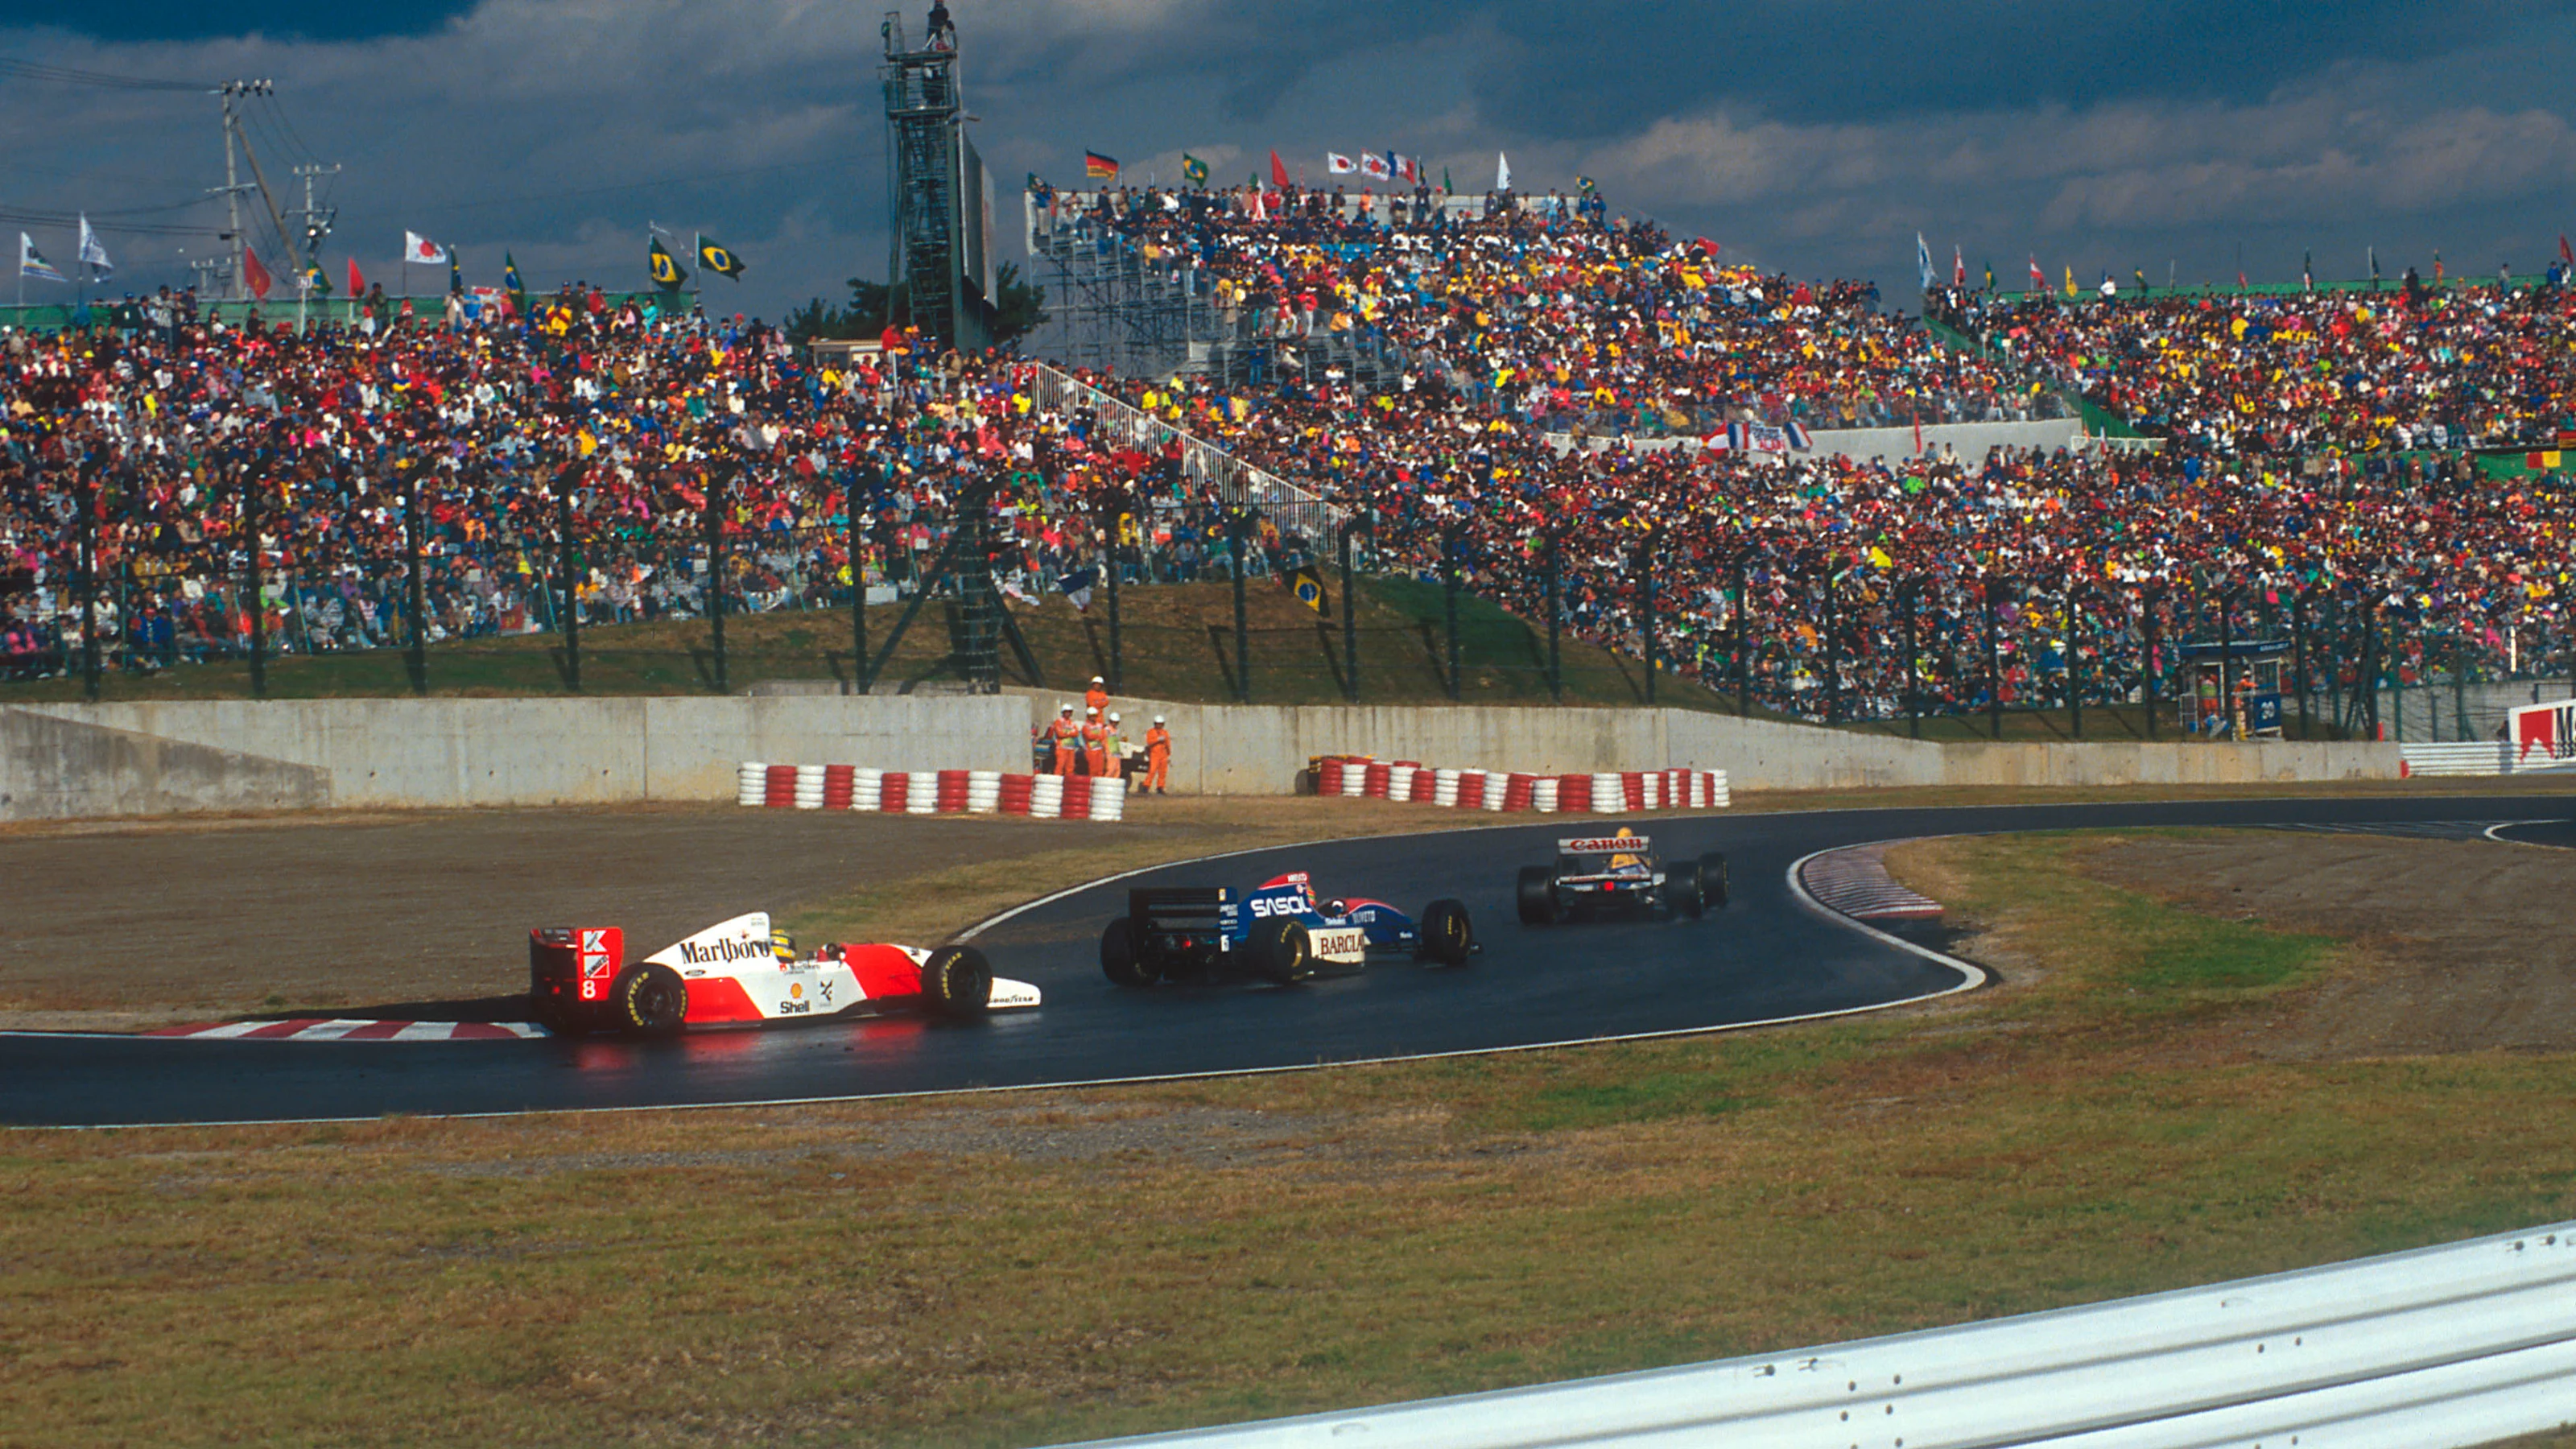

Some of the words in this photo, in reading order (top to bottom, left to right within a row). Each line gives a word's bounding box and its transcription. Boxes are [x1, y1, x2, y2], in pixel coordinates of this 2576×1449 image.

[2555, 705, 2576, 760] M
[1570, 838, 1642, 851] Canon
[1250, 896, 1312, 917] SASOL
[583, 930, 607, 952] K
[679, 937, 771, 964] Marlboro
[582, 980, 597, 999] 8
[779, 1000, 810, 1014] Shell
